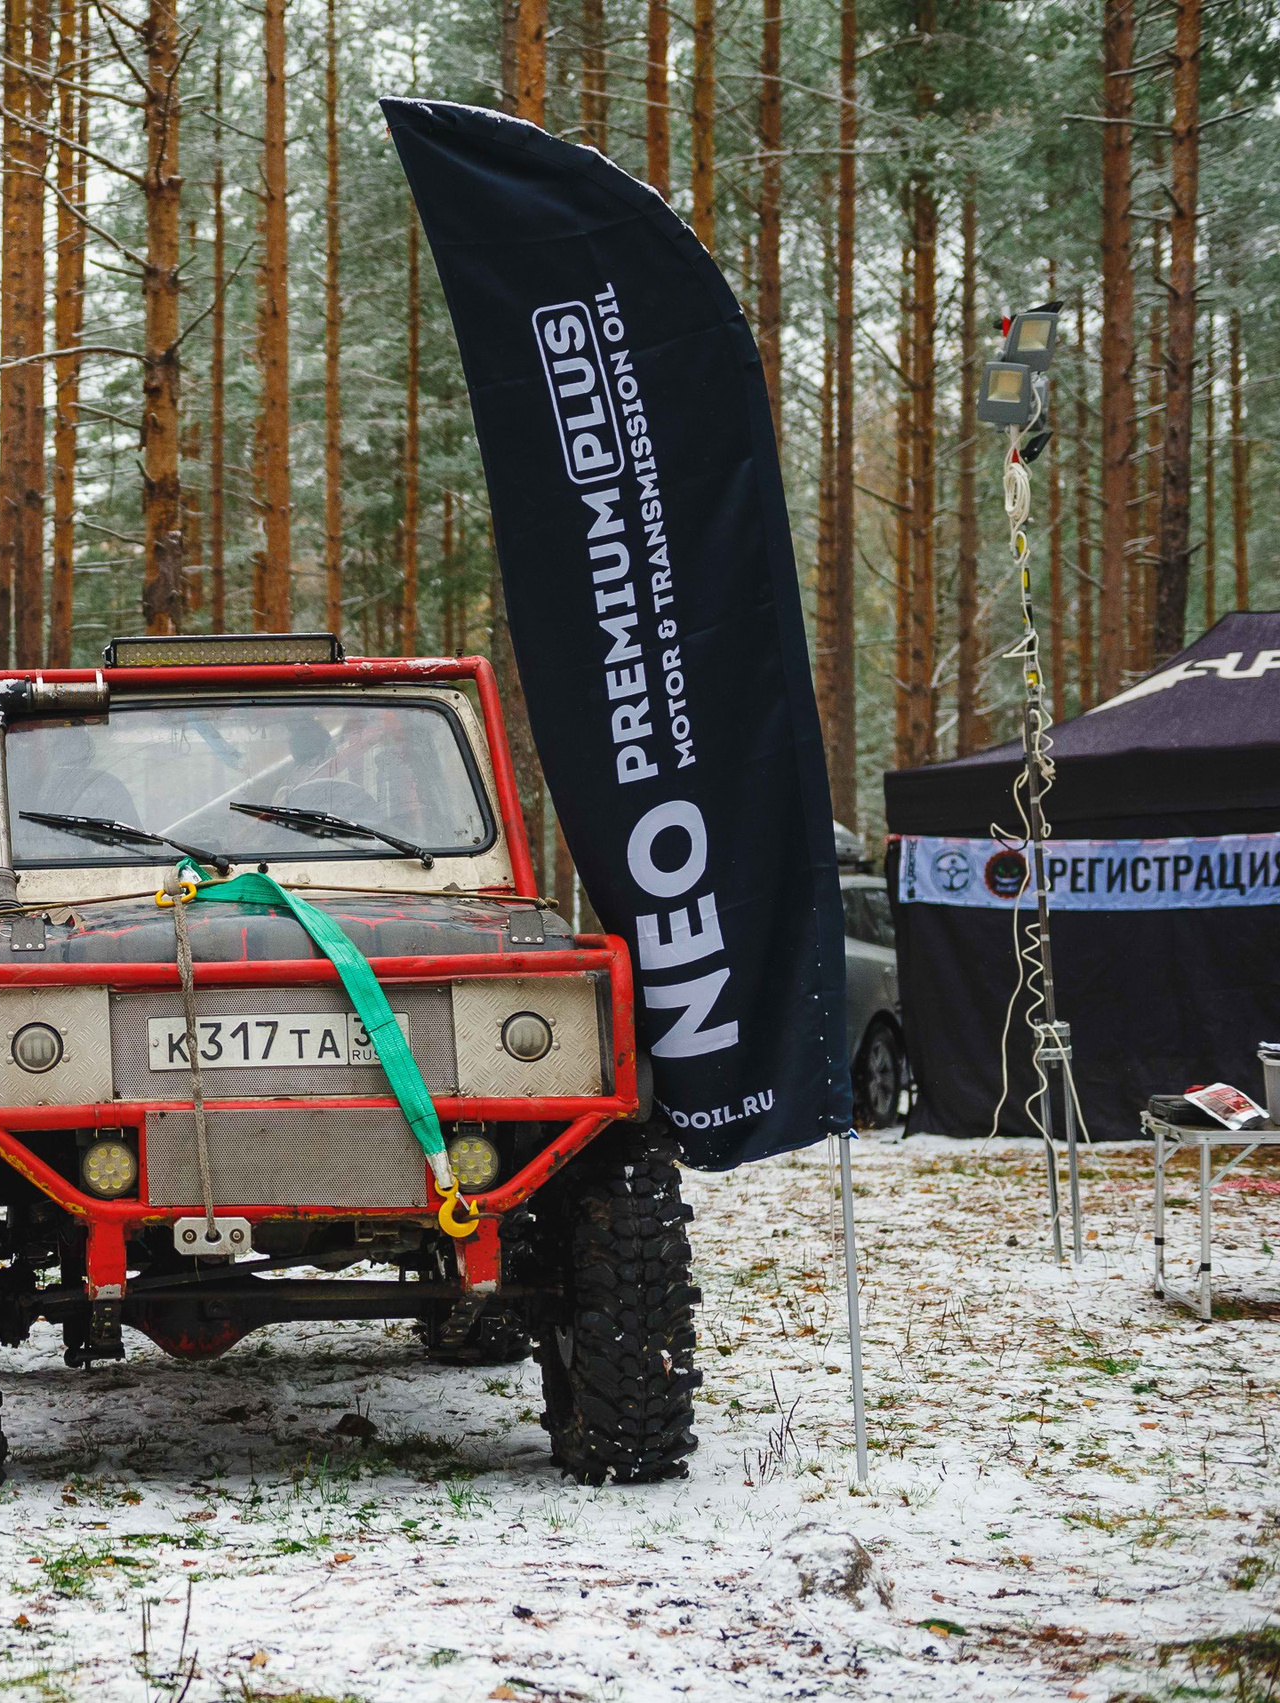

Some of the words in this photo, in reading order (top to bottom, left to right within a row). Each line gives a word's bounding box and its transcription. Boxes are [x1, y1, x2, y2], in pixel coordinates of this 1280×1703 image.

[595, 282, 625, 343] OIL
[543, 315, 614, 472] PLUS
[610, 349, 675, 613] TRANSMISSION
[580, 487, 659, 784] PREMIUM
[658, 619, 677, 639] &
[661, 645, 697, 769] MOTOR
[626, 800, 739, 1058] NEO
